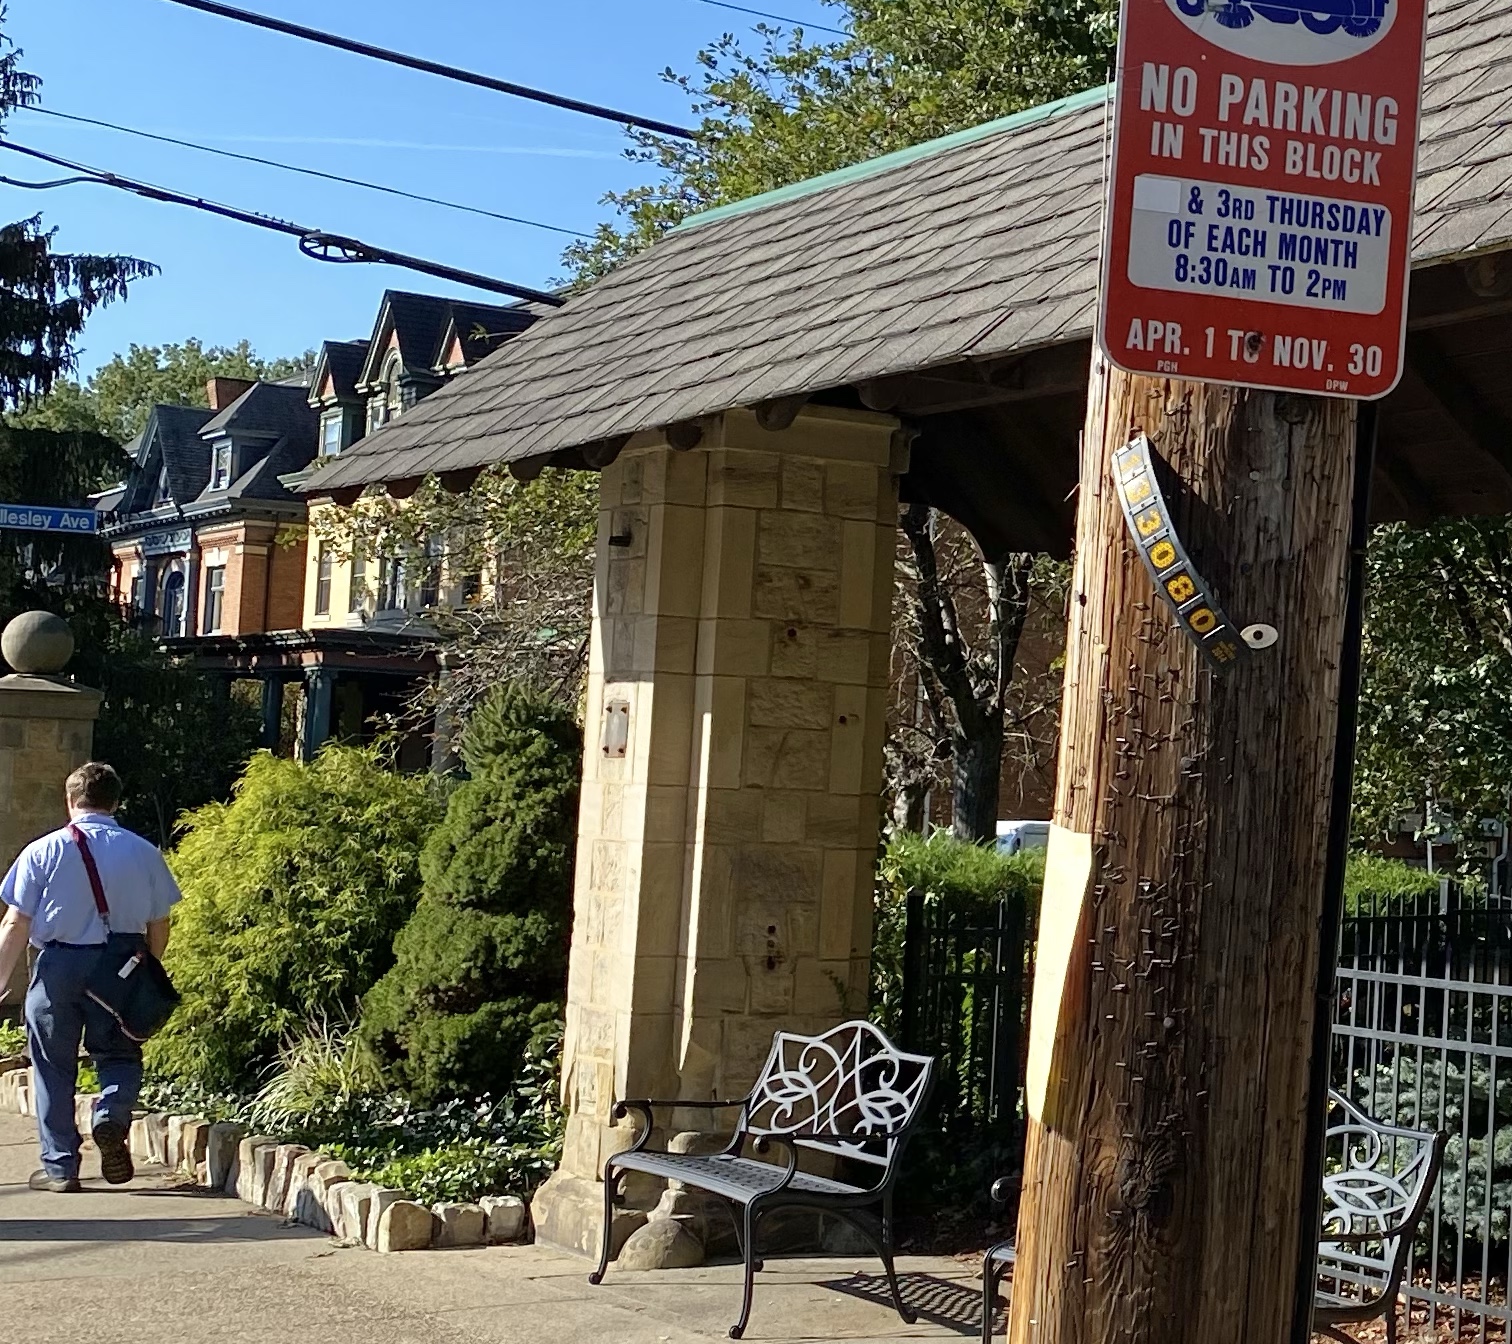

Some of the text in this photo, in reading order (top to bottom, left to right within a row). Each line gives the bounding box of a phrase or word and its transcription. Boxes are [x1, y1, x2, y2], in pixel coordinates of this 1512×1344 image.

[1140, 61, 1399, 146] NO PARKING
[1150, 120, 1382, 187] IN THIS BLOCK
[1187, 185, 1386, 237] & 3RD THURSDAY
[1167, 219, 1359, 270] OF EACH MONTH
[1174, 253, 1347, 301] 8:30AM TO 2PM
[1125, 317, 1383, 378] APR. 1 TO NOV. 30
[1156, 359, 1179, 373] PGH
[1325, 377, 1350, 392] DPW
[60, 512, 90, 529] Ave
